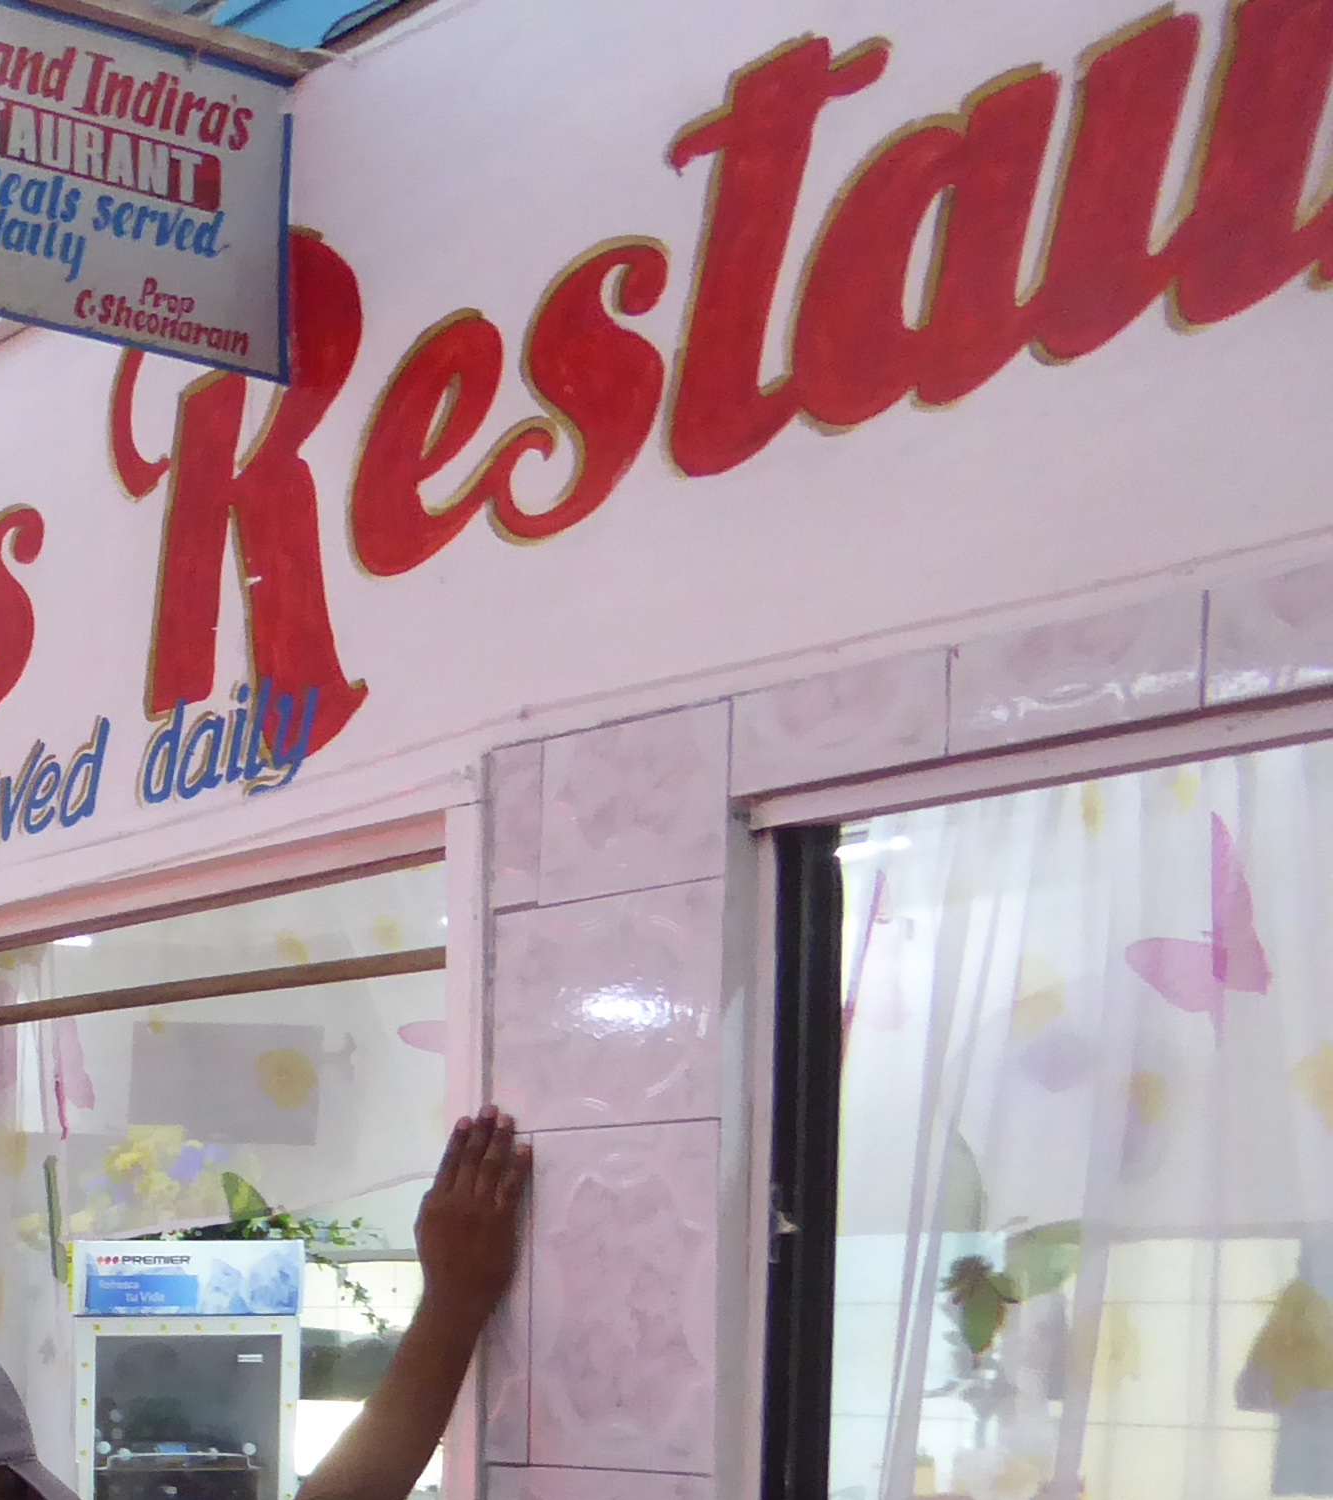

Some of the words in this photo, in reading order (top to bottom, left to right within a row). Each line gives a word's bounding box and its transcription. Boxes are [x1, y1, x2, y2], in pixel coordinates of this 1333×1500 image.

[72, 49, 254, 152] Indira's
[92, 195, 230, 259] served
[139, 277, 196, 319] Prop
[109, 0, 1333, 768] Restau
[136, 676, 319, 806] daily
[121, 1255, 191, 1266] PREMIER
